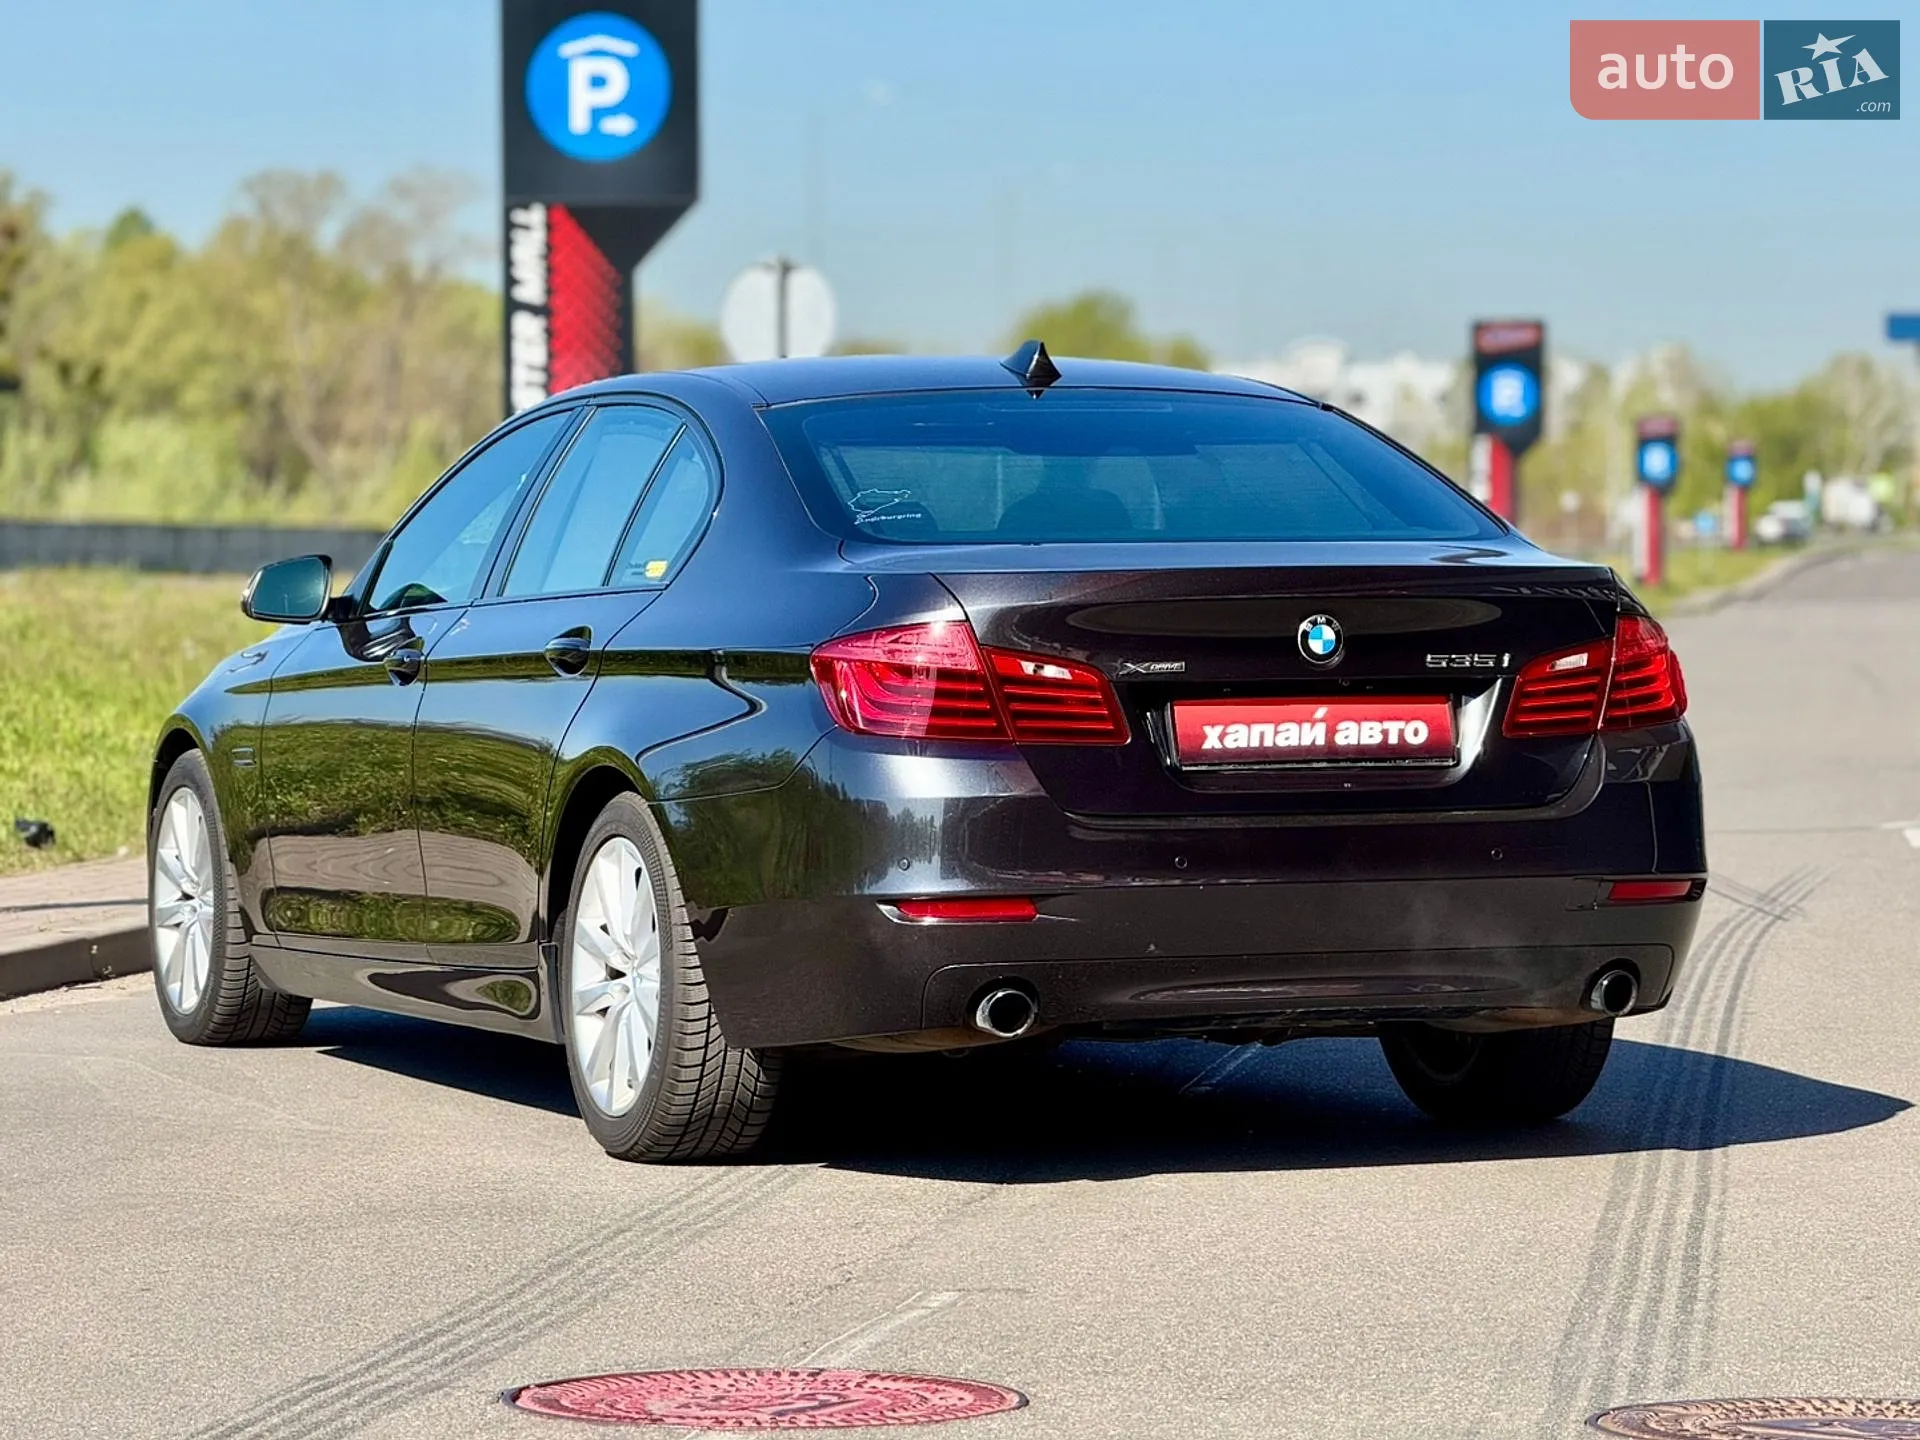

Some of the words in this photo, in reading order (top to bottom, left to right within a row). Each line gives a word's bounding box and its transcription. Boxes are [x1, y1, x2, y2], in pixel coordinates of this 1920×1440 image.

[1304, 616, 1341, 632] BMW
[1425, 652, 1511, 668] 535i
[1201, 707, 1328, 750] хапай
[1334, 719, 1429, 746] авто
